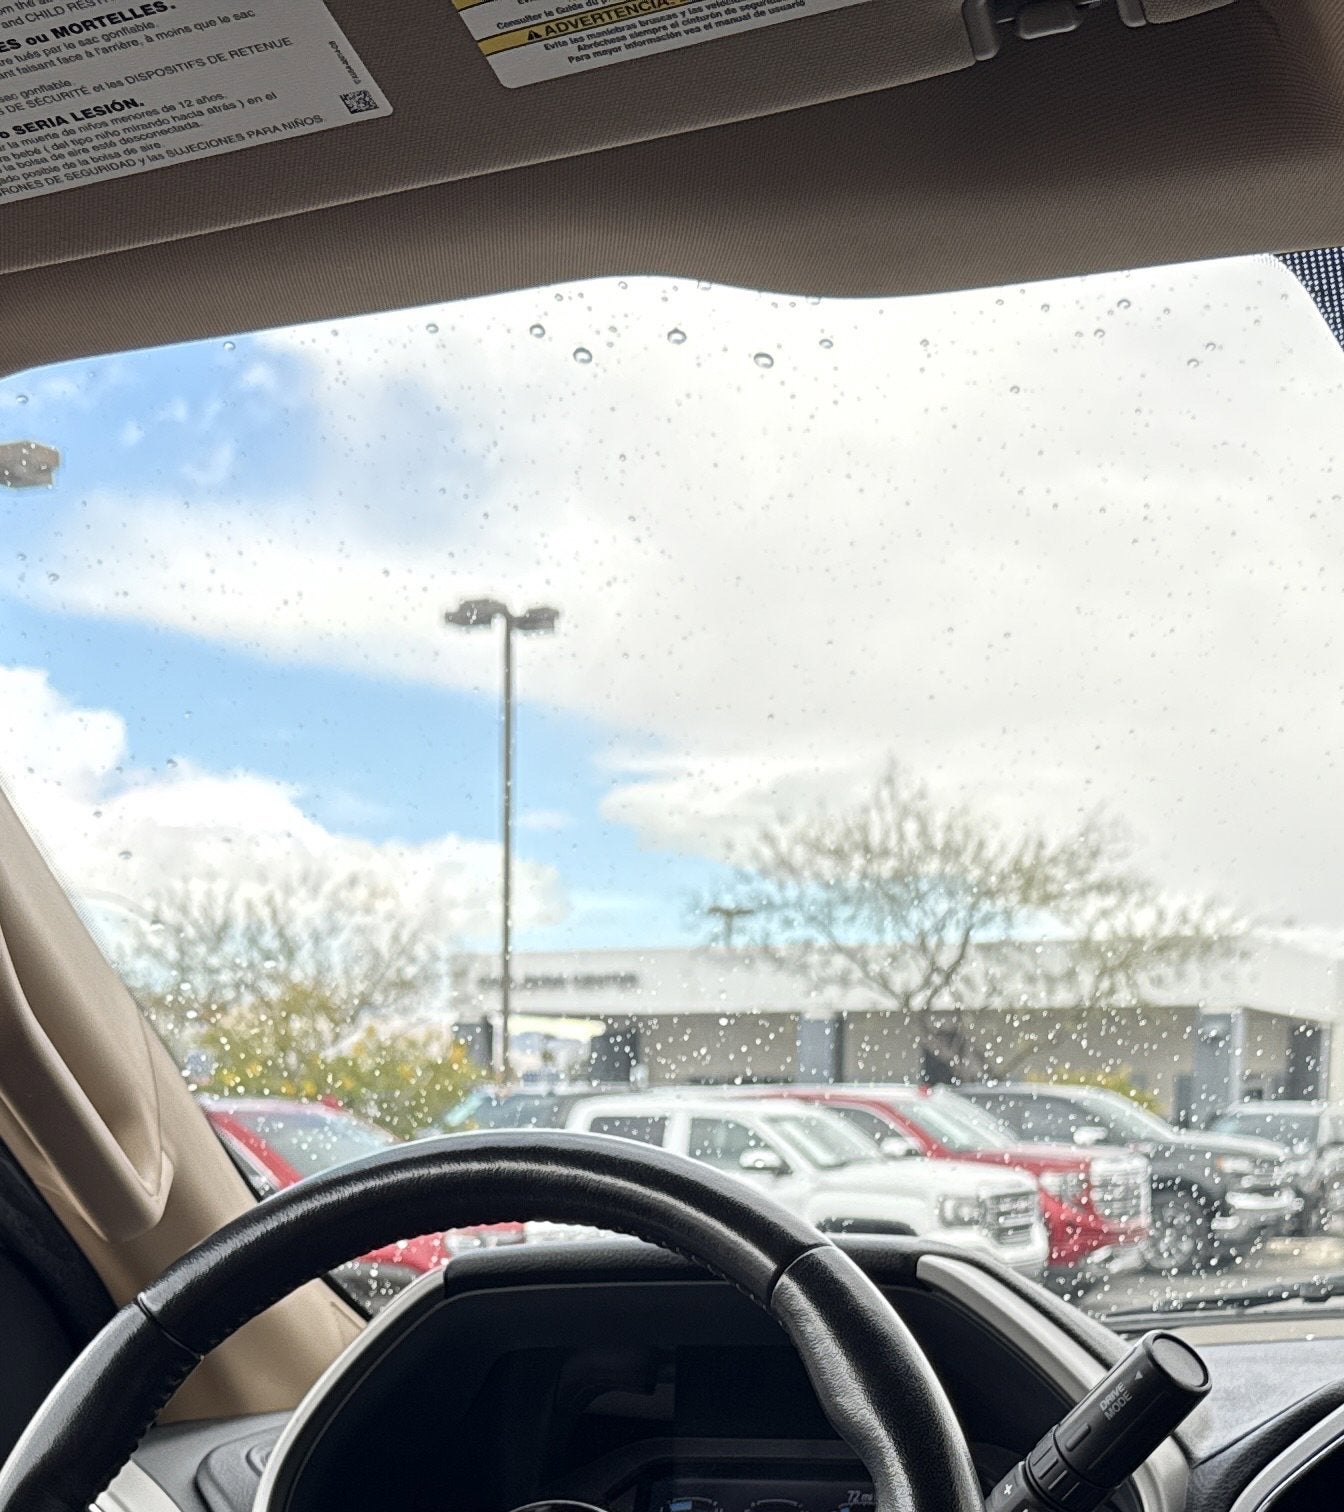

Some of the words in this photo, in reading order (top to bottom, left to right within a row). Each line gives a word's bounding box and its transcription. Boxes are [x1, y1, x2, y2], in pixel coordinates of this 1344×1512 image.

[23, 5, 67, 23] CHILD
[23, 33, 50, 46] ou
[48, 0, 177, 39] MORTELLES.
[4, 102, 26, 113] DE
[22, 83, 91, 108] SÉCURITÉ
[90, 83, 106, 92] et
[103, 78, 125, 89] les
[123, 57, 207, 84] DISPOSITIFS
[205, 52, 228, 64] DE
[227, 36, 294, 59] RETENUE
[10, 114, 69, 136] SERIA
[67, 94, 145, 122] LESIÓN.
[1099, 1382, 1126, 1411] DRIVE
[1104, 1389, 1132, 1421] MODE
